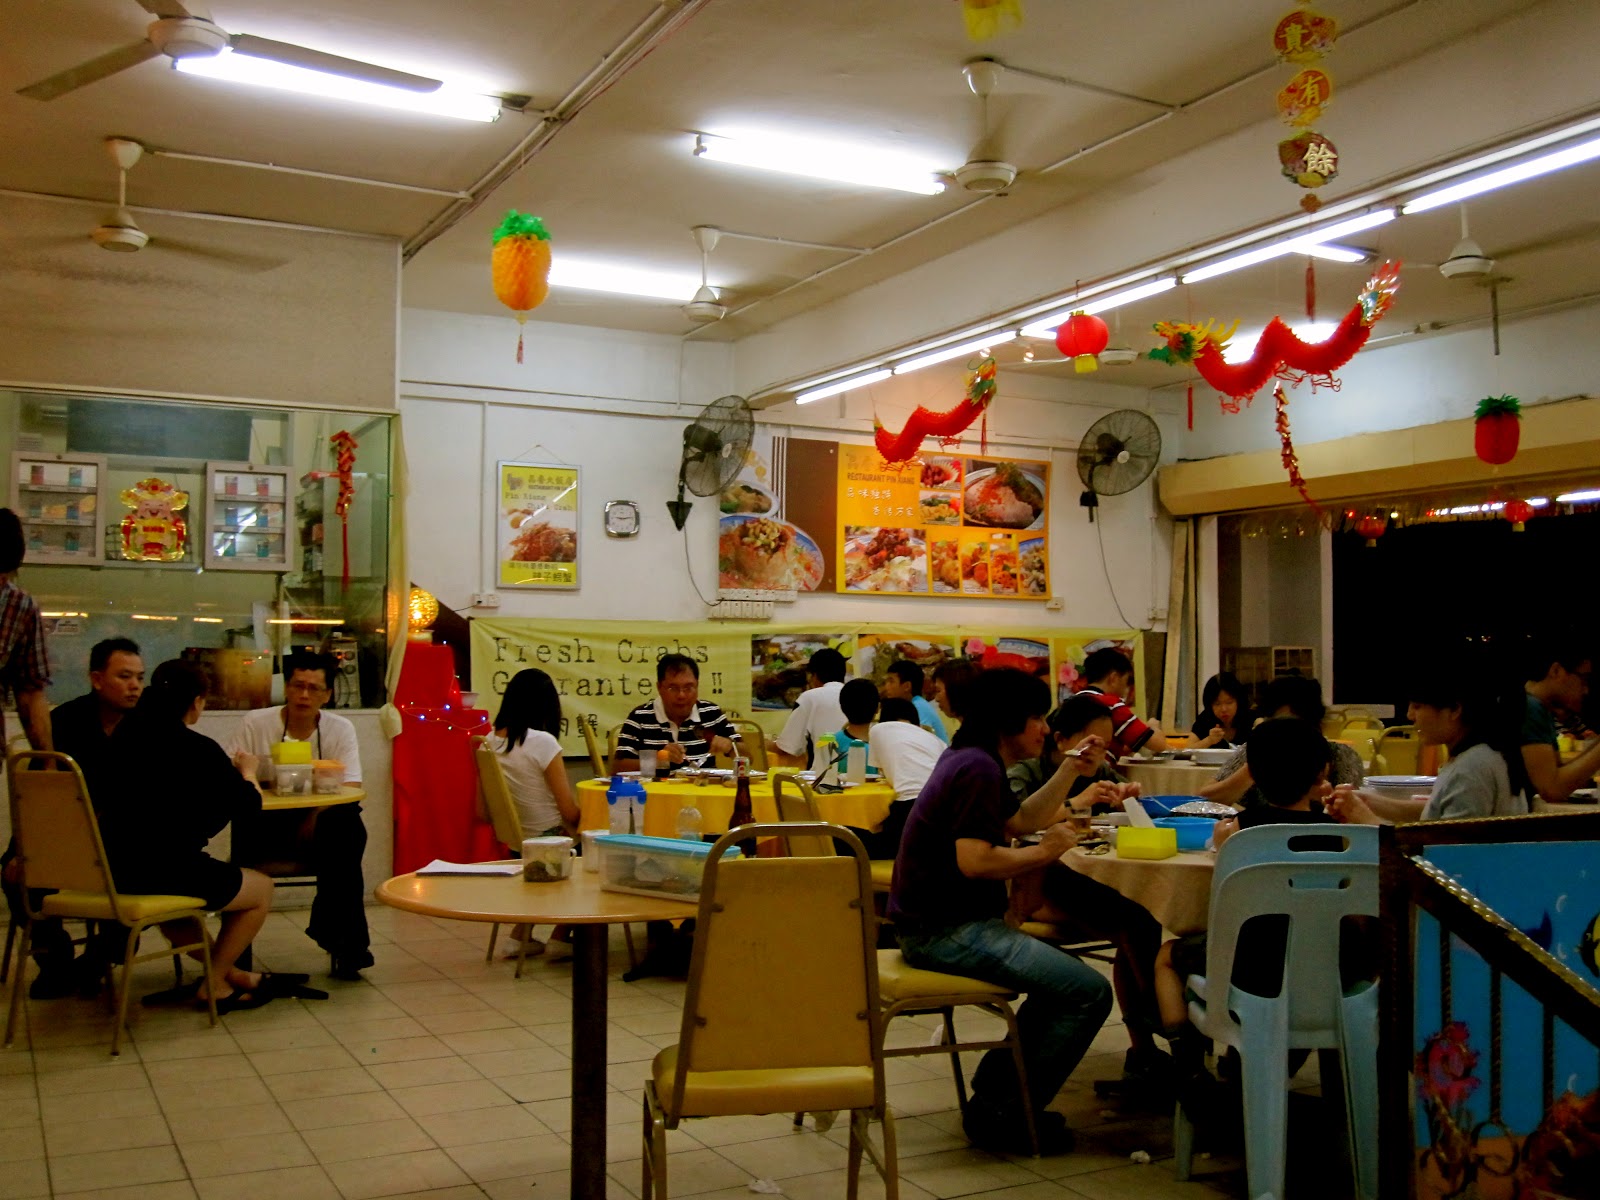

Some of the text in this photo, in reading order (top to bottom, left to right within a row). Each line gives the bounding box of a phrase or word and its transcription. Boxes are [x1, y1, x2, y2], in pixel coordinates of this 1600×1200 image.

[1300, 75, 1324, 106] 有
[1303, 142, 1338, 177] 餘
[847, 472, 885, 482] RESTAURANT
[493, 636, 708, 663] Fresh Crabs
